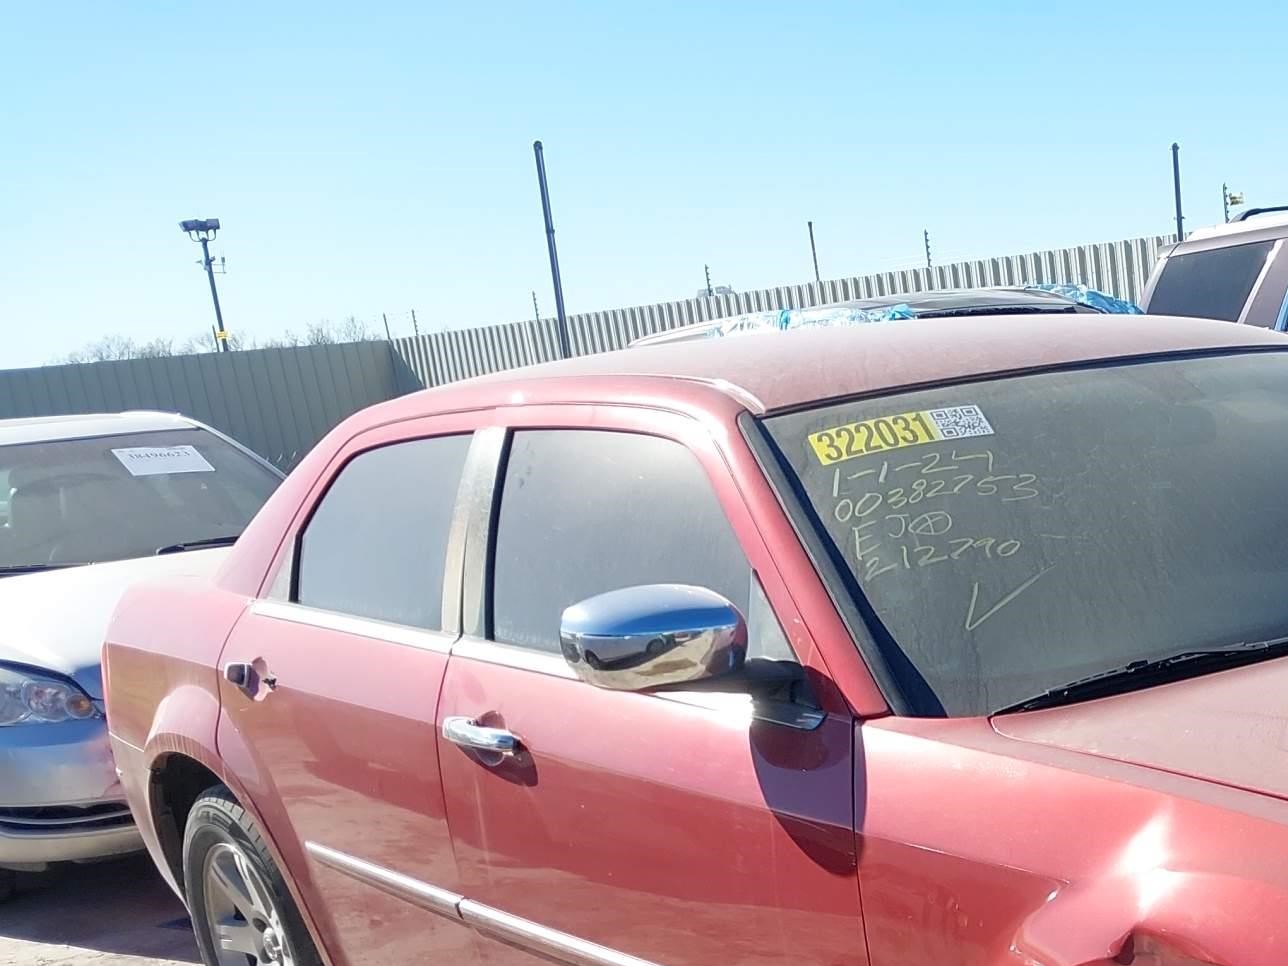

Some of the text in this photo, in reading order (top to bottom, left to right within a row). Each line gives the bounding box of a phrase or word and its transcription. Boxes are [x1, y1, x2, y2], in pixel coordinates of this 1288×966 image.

[815, 412, 936, 462] 322031
[832, 449, 994, 497] 1-1-24
[833, 473, 1040, 522] 00382753
